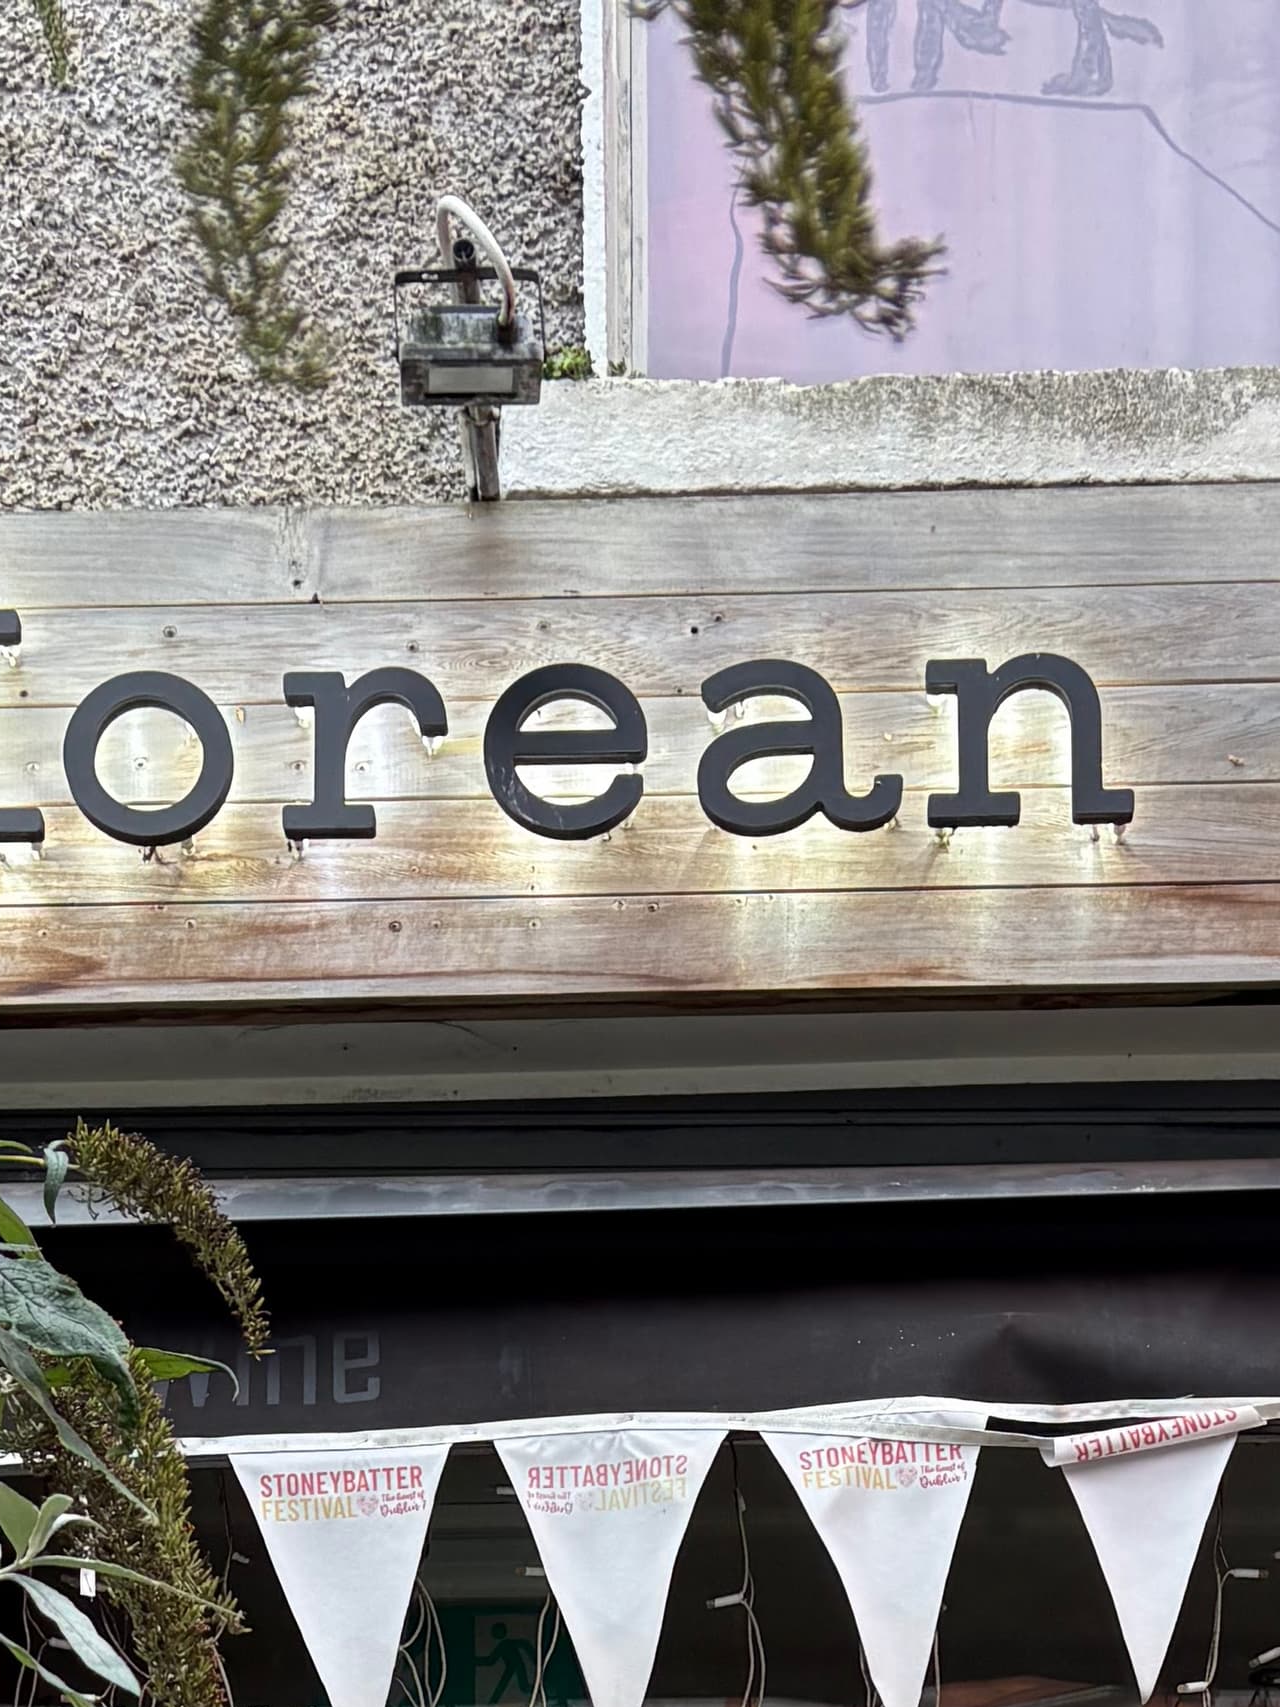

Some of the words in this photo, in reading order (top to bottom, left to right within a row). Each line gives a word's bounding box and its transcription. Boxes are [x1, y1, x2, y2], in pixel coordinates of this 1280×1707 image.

[799, 1440, 963, 1471] STONEYBATTER
[259, 1465, 424, 1498] STONEYBATTER
[802, 1465, 898, 1490] FESTIVAL
[261, 1496, 359, 1522] FESTIVAL
